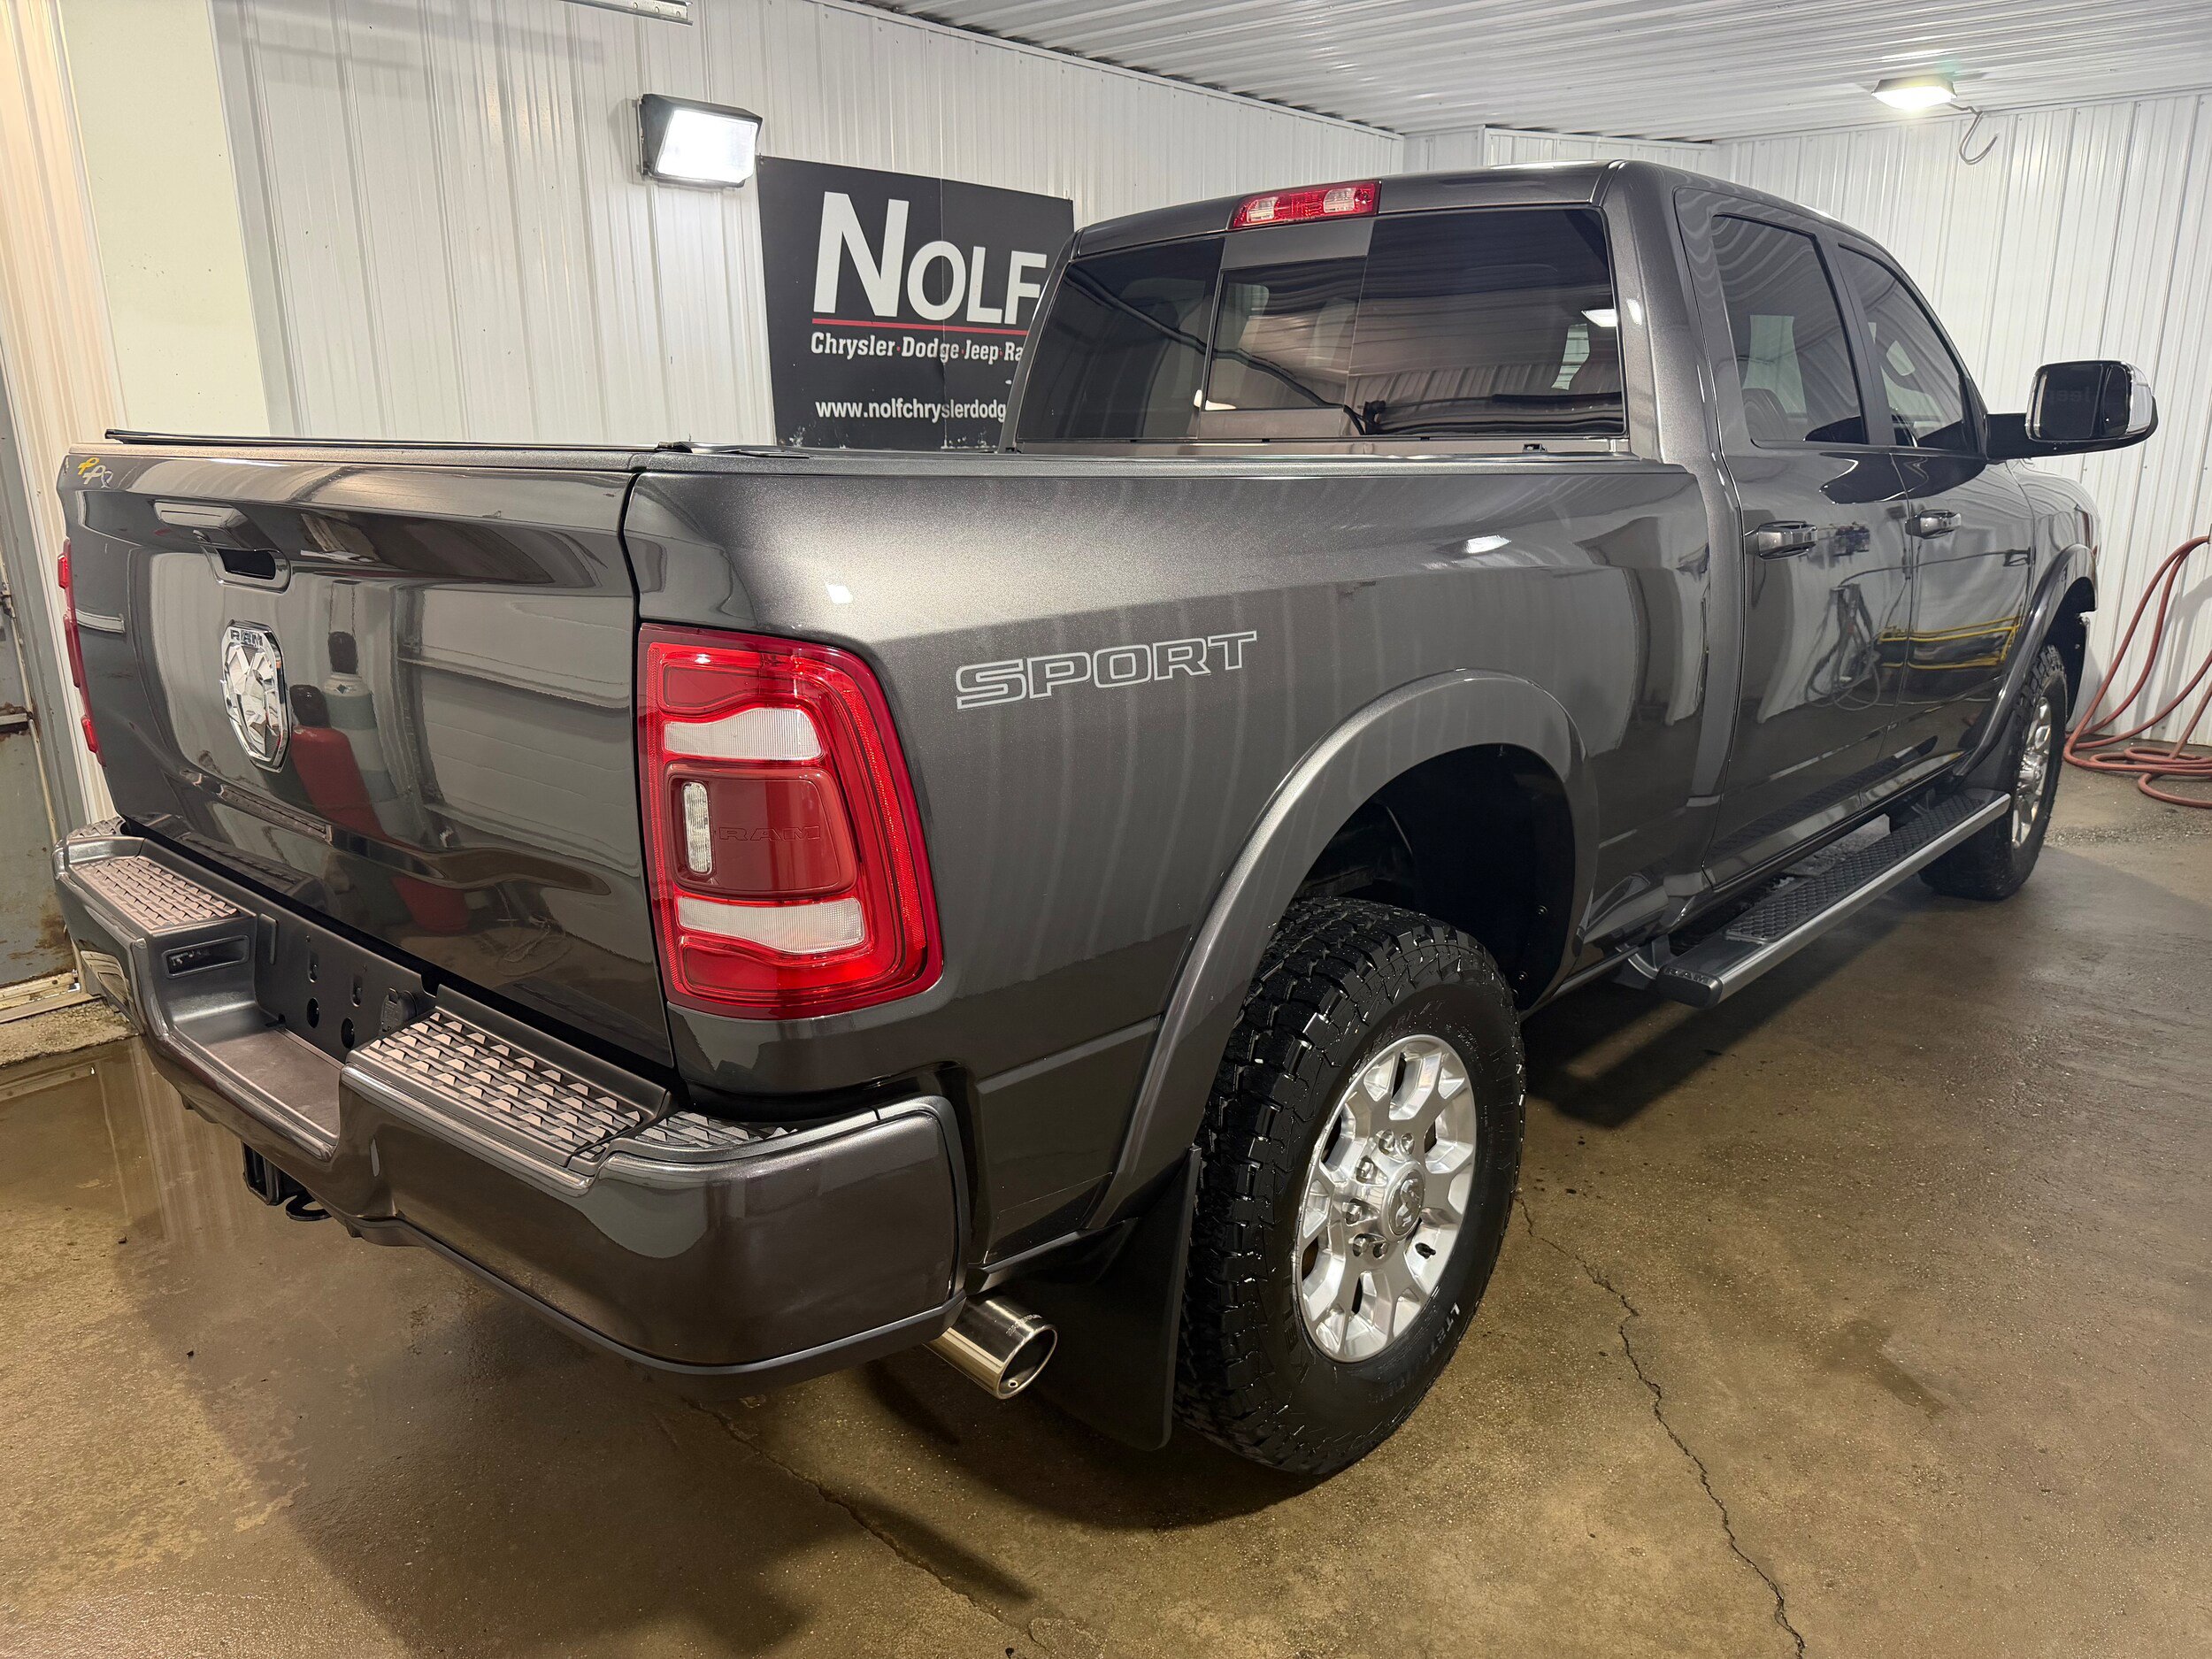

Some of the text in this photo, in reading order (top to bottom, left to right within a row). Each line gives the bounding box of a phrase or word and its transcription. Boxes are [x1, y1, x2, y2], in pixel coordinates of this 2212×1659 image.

[813, 191, 1048, 325] NOLF
[810, 332, 895, 359] Chrysler
[901, 336, 959, 363] Dodge
[964, 340, 999, 365] Jeep
[815, 398, 1007, 423] www.nolfchryslerdodg
[230, 629, 264, 647] RAM
[955, 630, 1257, 710] SPORT
[718, 826, 820, 841] RAM
